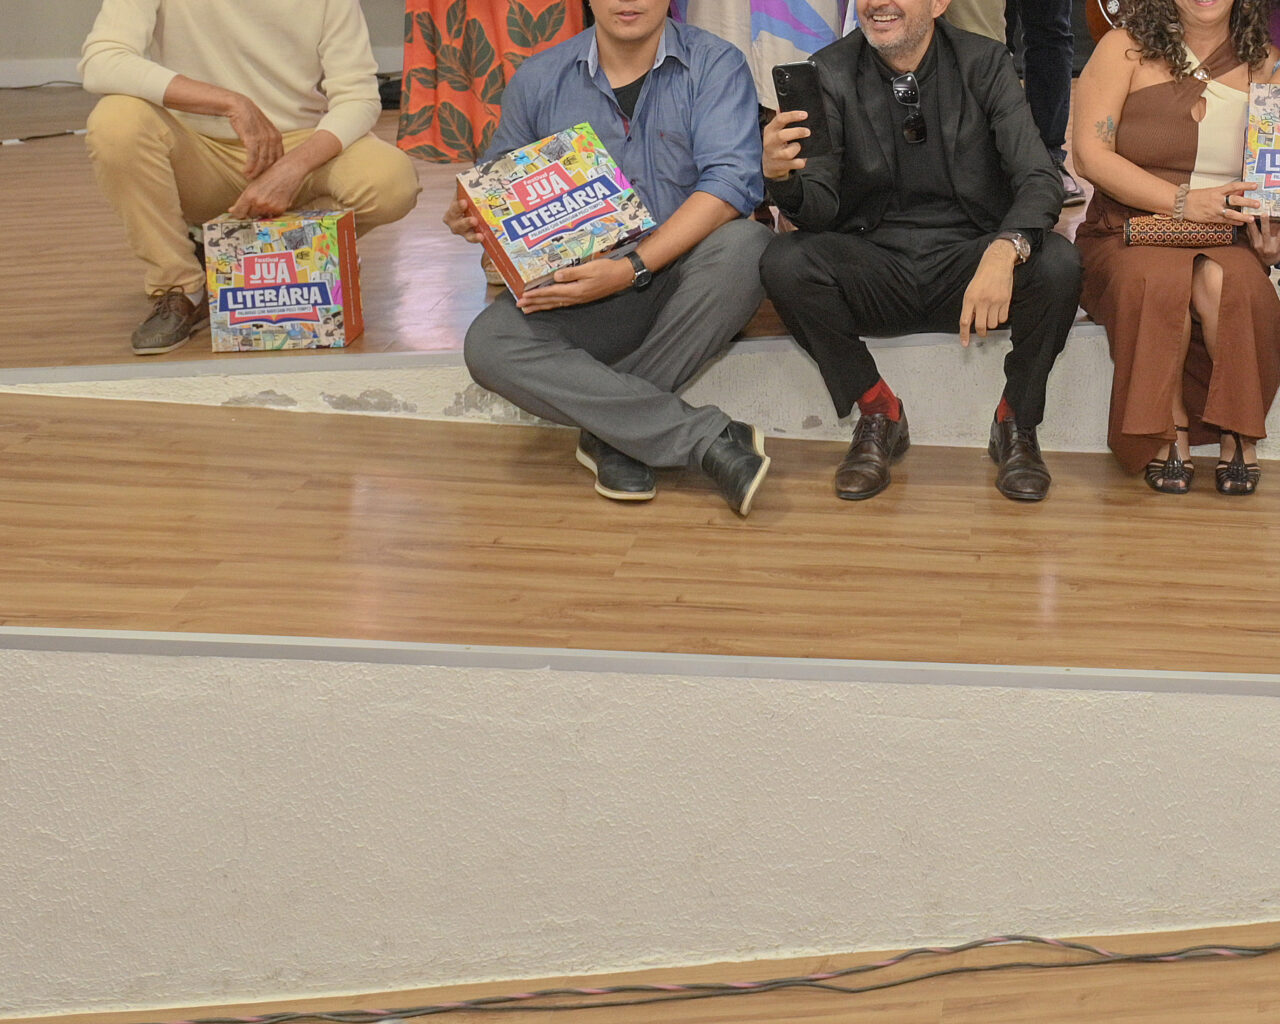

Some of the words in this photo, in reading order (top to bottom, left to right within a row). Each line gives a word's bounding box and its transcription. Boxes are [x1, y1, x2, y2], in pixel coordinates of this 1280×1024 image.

[526, 171, 570, 205] JUÁ
[510, 181, 611, 236] LITERÁRIA
[249, 259, 291, 284] JUÁ
[226, 286, 323, 309] LITERÁRIA
